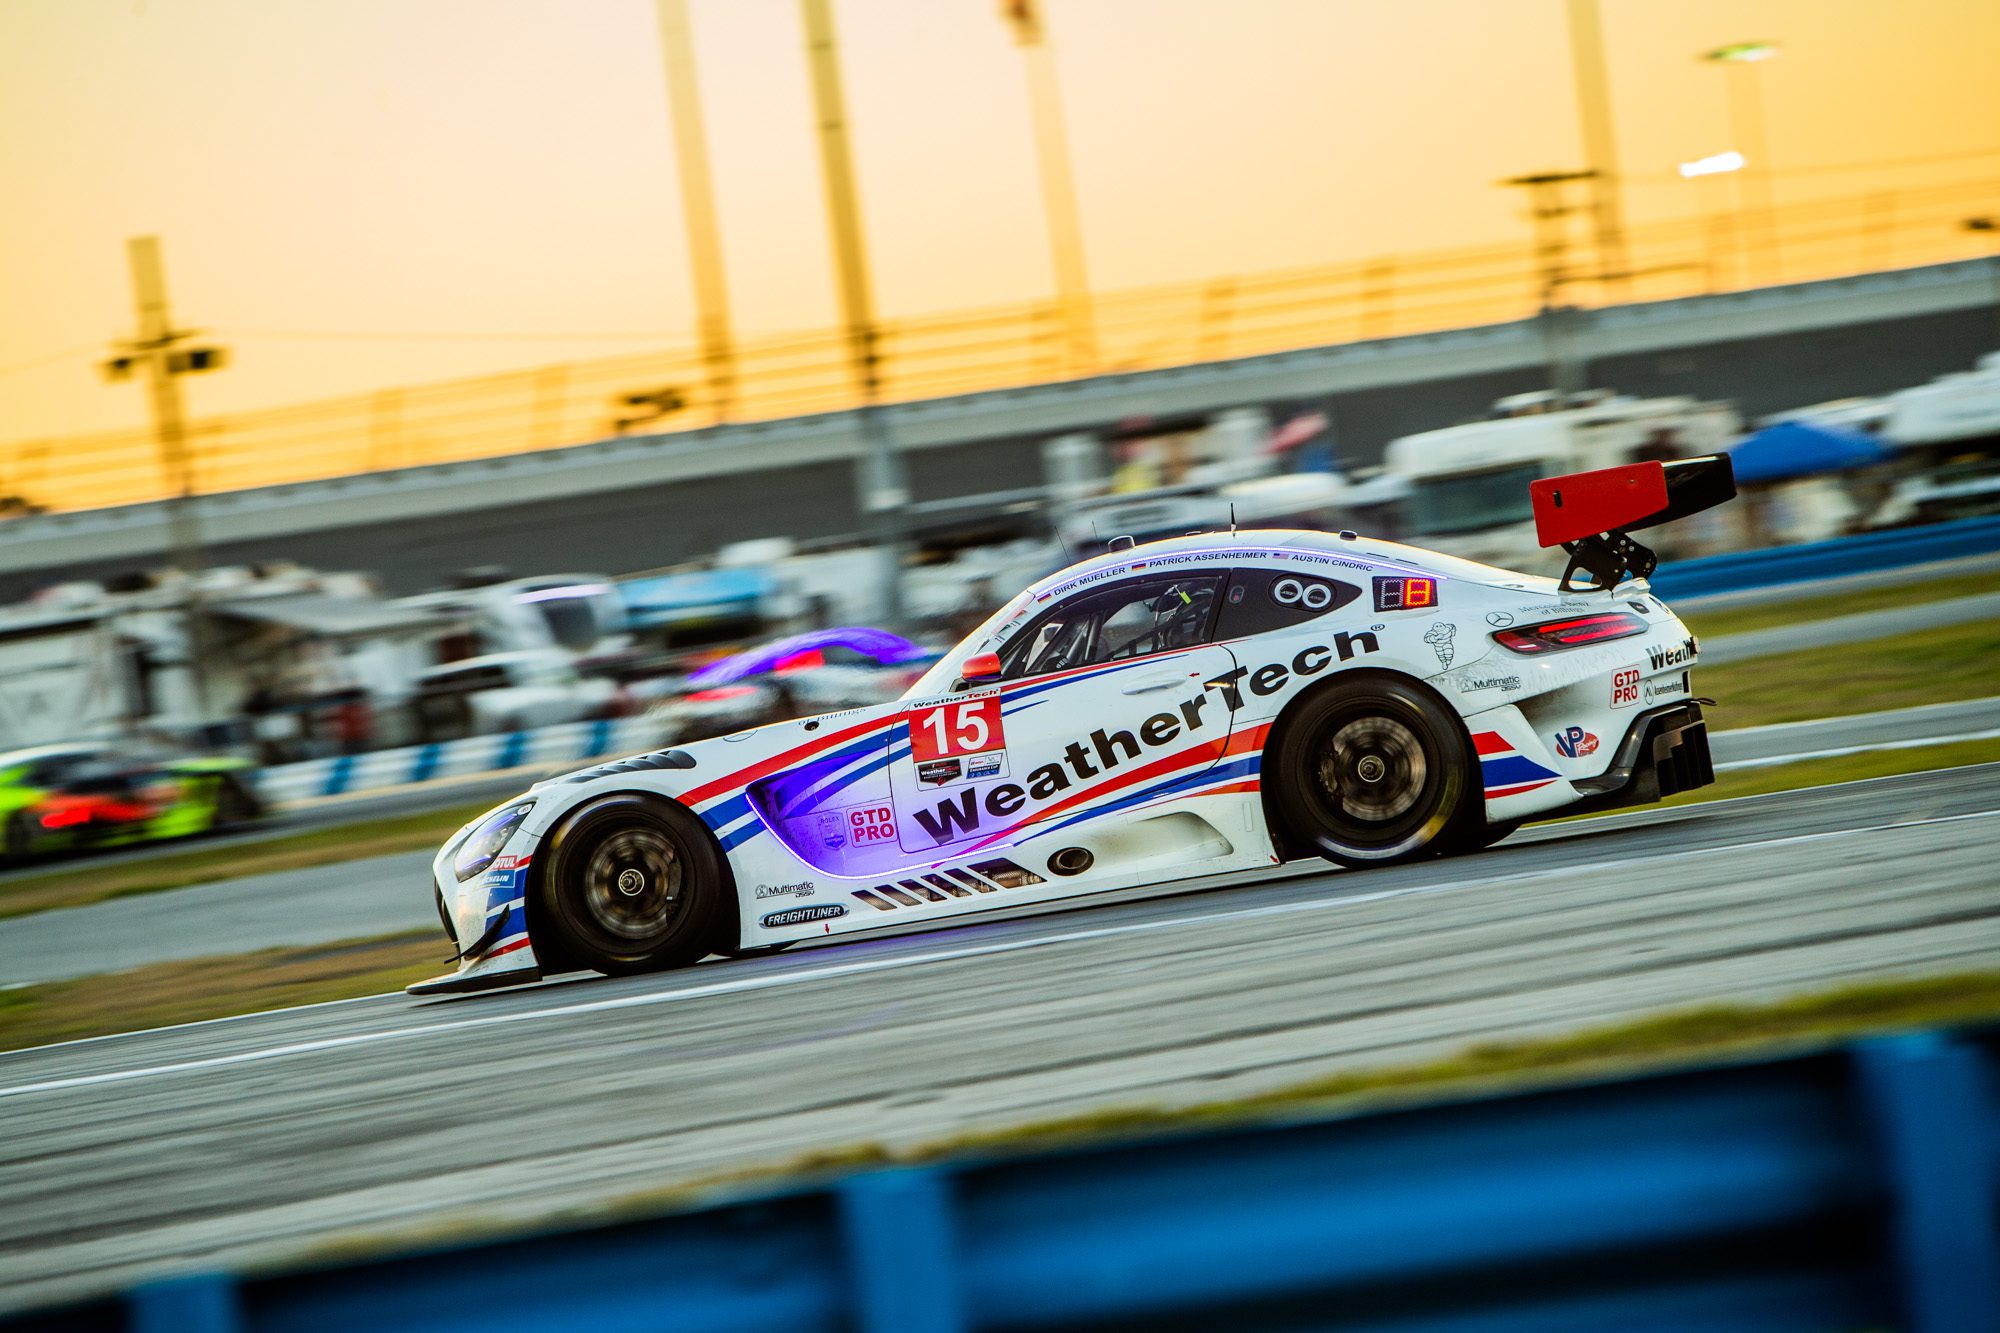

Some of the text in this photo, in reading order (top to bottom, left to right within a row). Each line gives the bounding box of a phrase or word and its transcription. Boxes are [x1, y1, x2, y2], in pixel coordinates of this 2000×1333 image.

[1149, 551, 1267, 568] PATRICK ASSENHEIMER
[1291, 554, 1374, 572] AUSTIN CINDRIC
[1053, 567, 1126, 596] DIRK MUELLER
[1473, 675, 1520, 689] Multimatic
[1613, 669, 1640, 688] GTD
[1613, 684, 1639, 704] PRO
[923, 701, 989, 755] 15
[1554, 726, 1585, 758] VP
[850, 807, 891, 827] GTD
[853, 823, 895, 843] PRO
[768, 881, 814, 896] Multimatic
[767, 906, 841, 926] FREIGHTLINER
